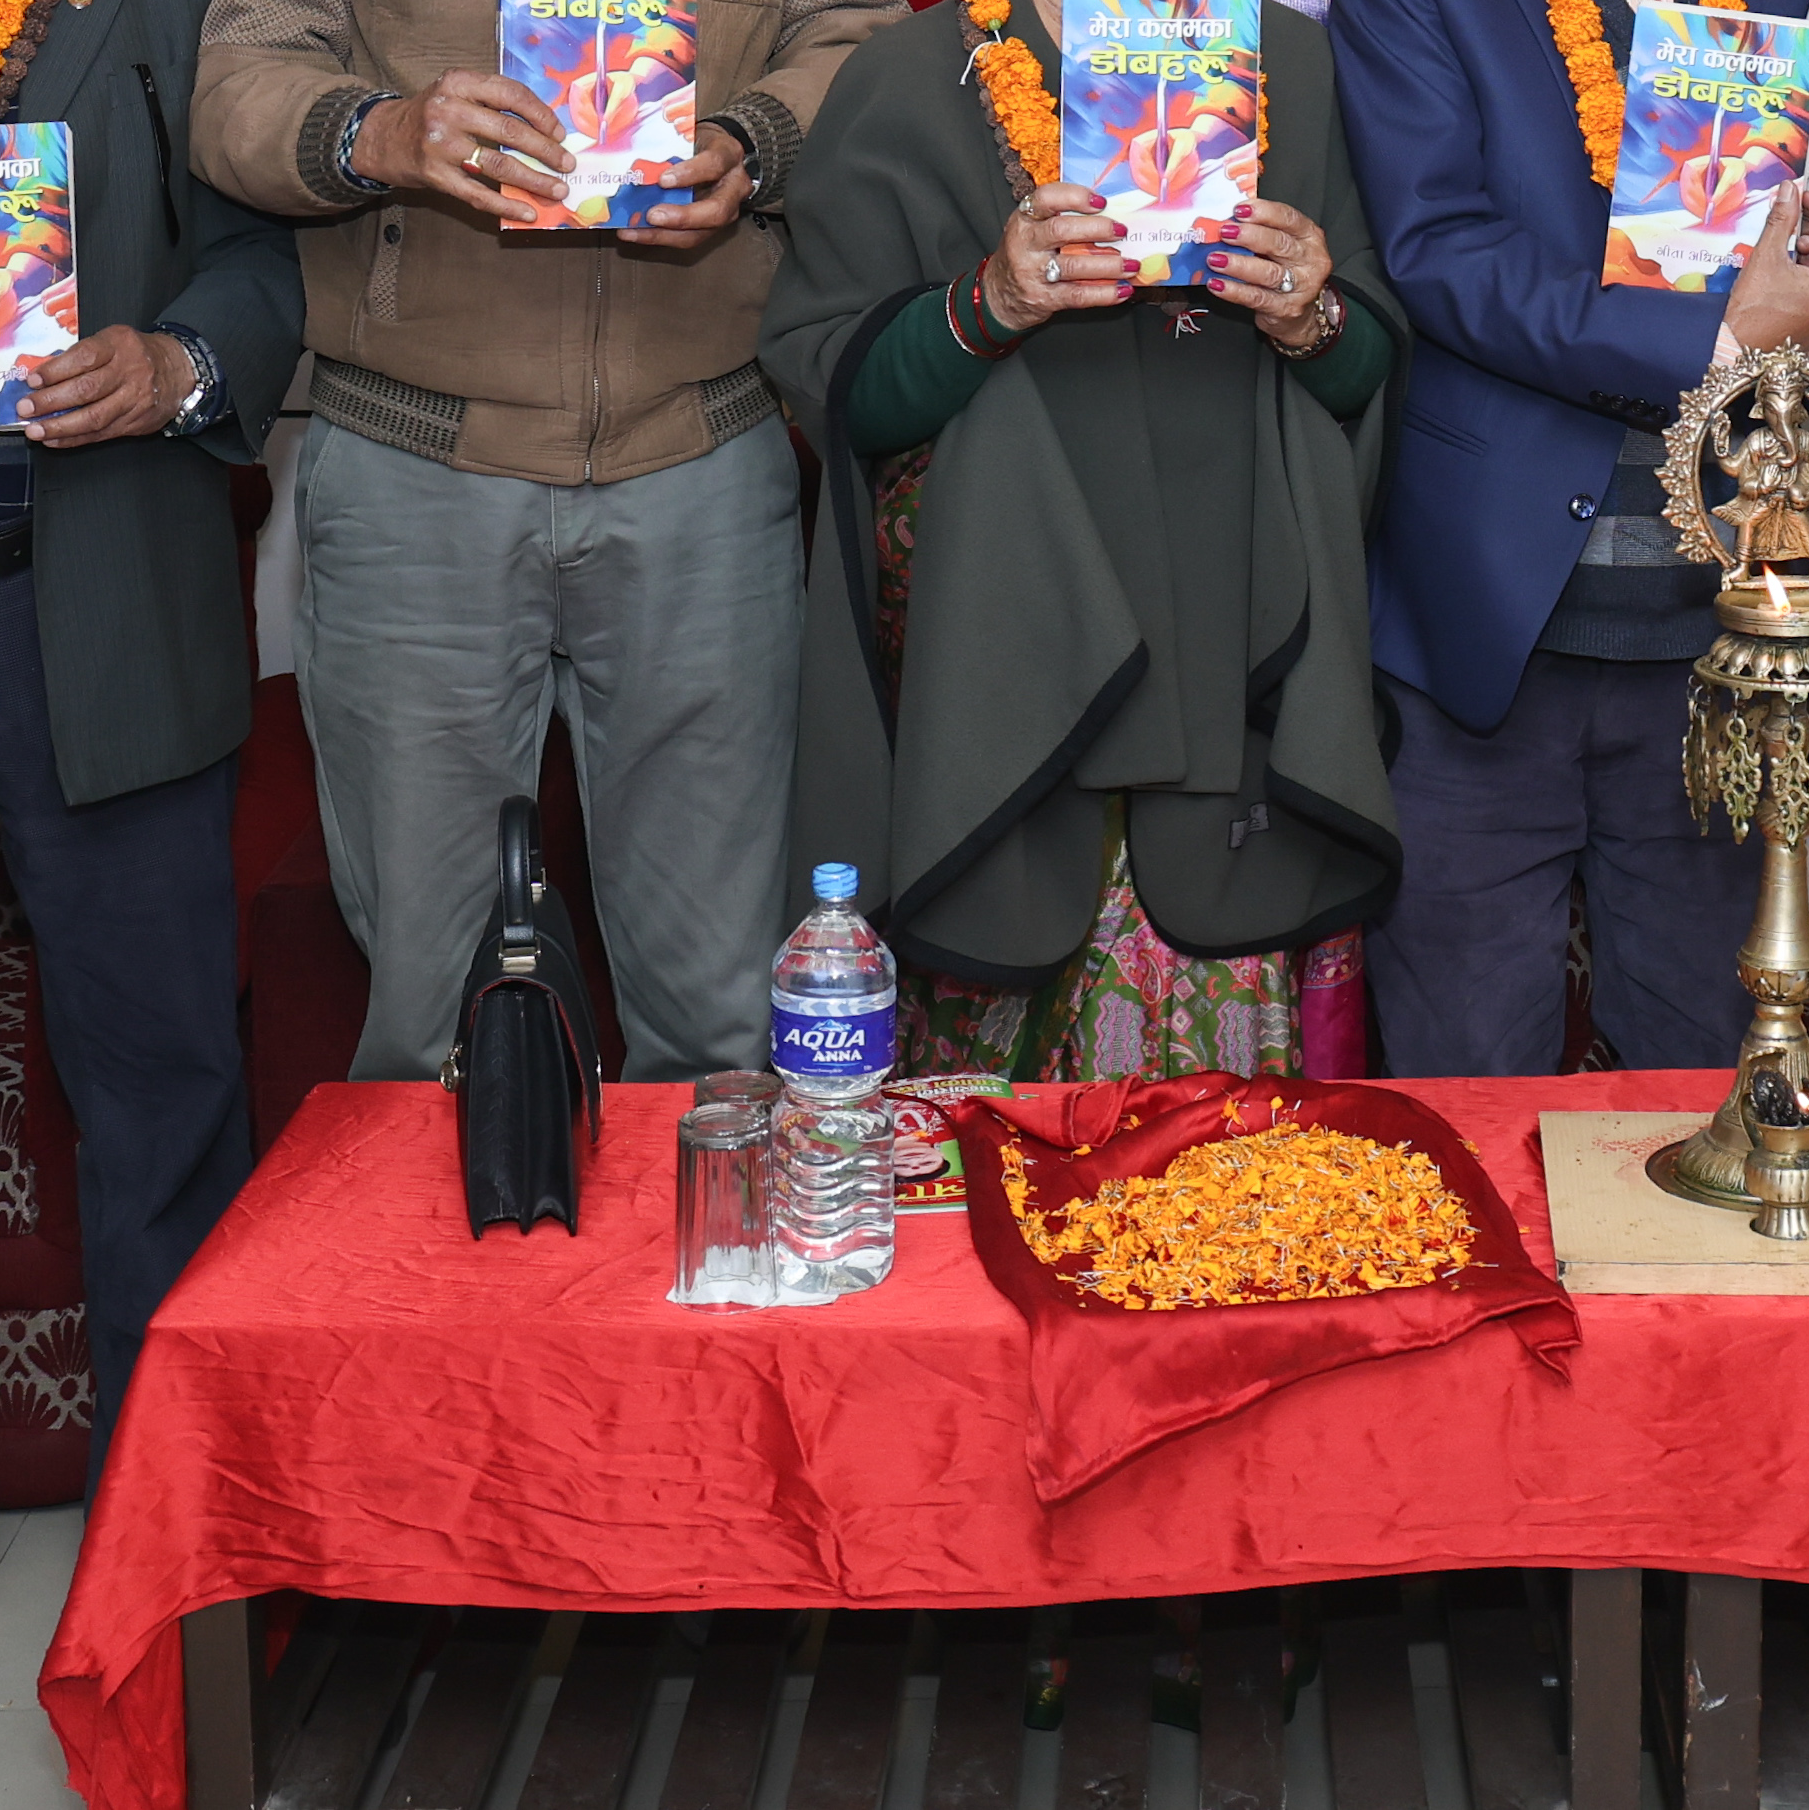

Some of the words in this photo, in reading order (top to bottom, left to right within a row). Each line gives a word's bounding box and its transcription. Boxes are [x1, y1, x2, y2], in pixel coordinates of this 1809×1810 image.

[1089, 12, 1130, 39] मेरा
[1138, 17, 1233, 39] कलमका
[1089, 41, 1233, 84] डोबहरू
[1655, 37, 1699, 66] मेरा
[1703, 47, 1796, 78] कलमका
[1652, 67, 1792, 119] डोबहरू
[1656, 245, 1683, 260] गीता
[784, 1028, 866, 1051] AQUA
[813, 1049, 863, 1063] ANNA
